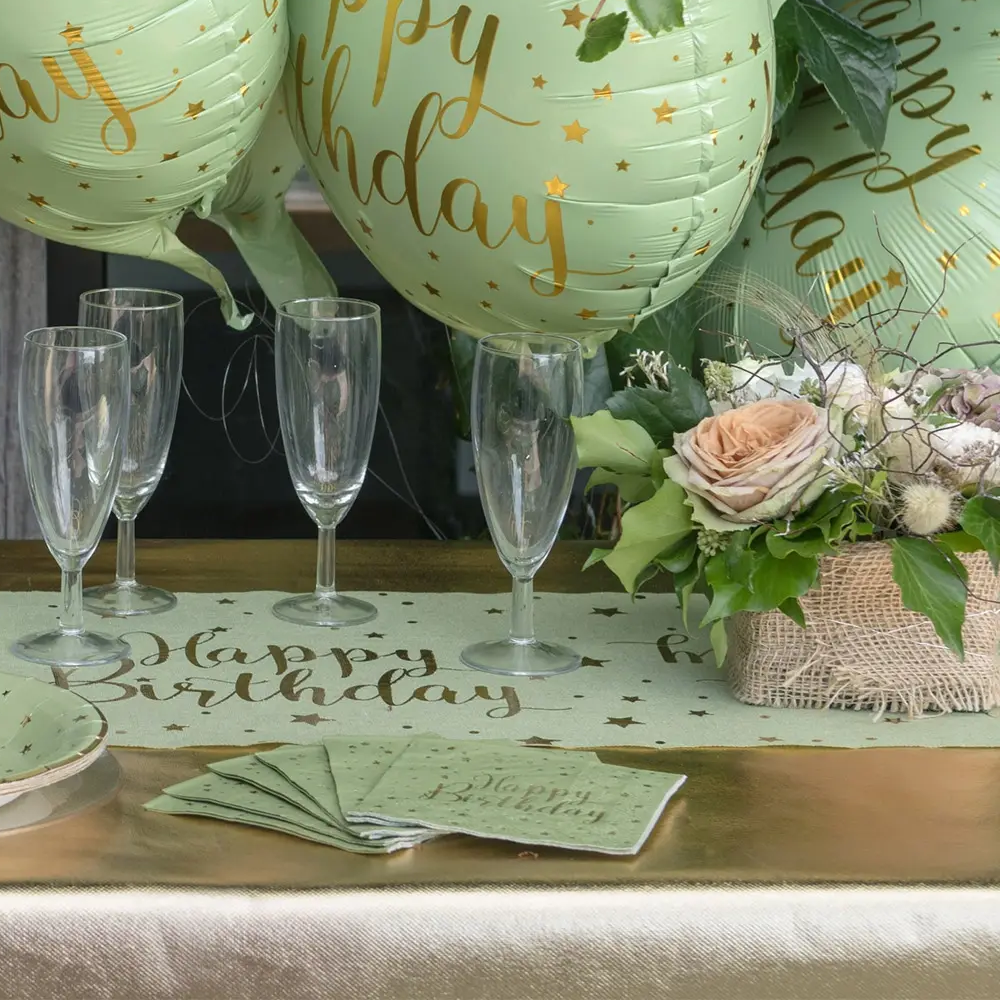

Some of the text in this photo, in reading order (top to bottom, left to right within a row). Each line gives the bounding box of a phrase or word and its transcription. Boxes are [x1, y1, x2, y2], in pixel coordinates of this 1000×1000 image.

[290, 34, 634, 297] thday
[119, 626, 465, 679] Happy
[50, 657, 571, 718] Birthday
[419, 782, 606, 824] Birthday
[473, 773, 610, 805] Happy
